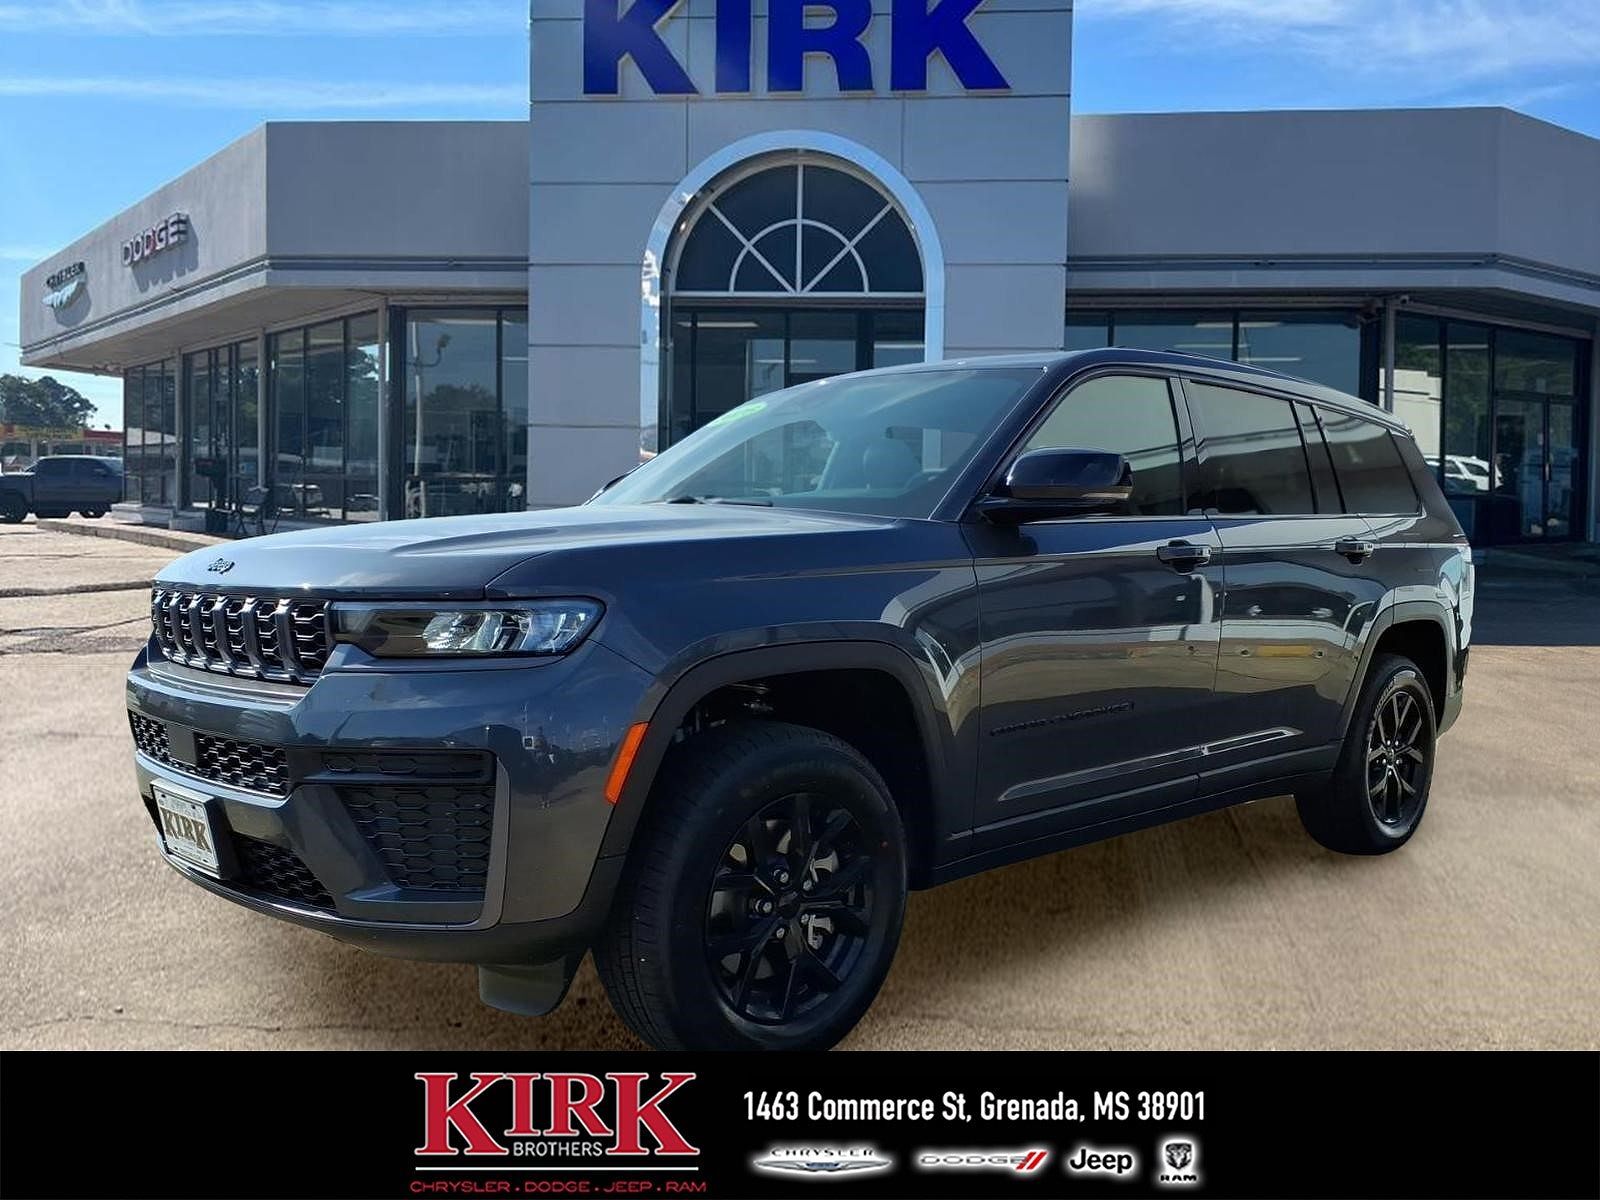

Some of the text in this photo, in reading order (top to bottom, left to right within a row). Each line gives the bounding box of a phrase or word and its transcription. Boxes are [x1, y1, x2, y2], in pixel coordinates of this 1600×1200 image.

[583, 0, 1011, 96] KIRK
[121, 212, 189, 266] DODGE
[160, 806, 212, 853] KIRK
